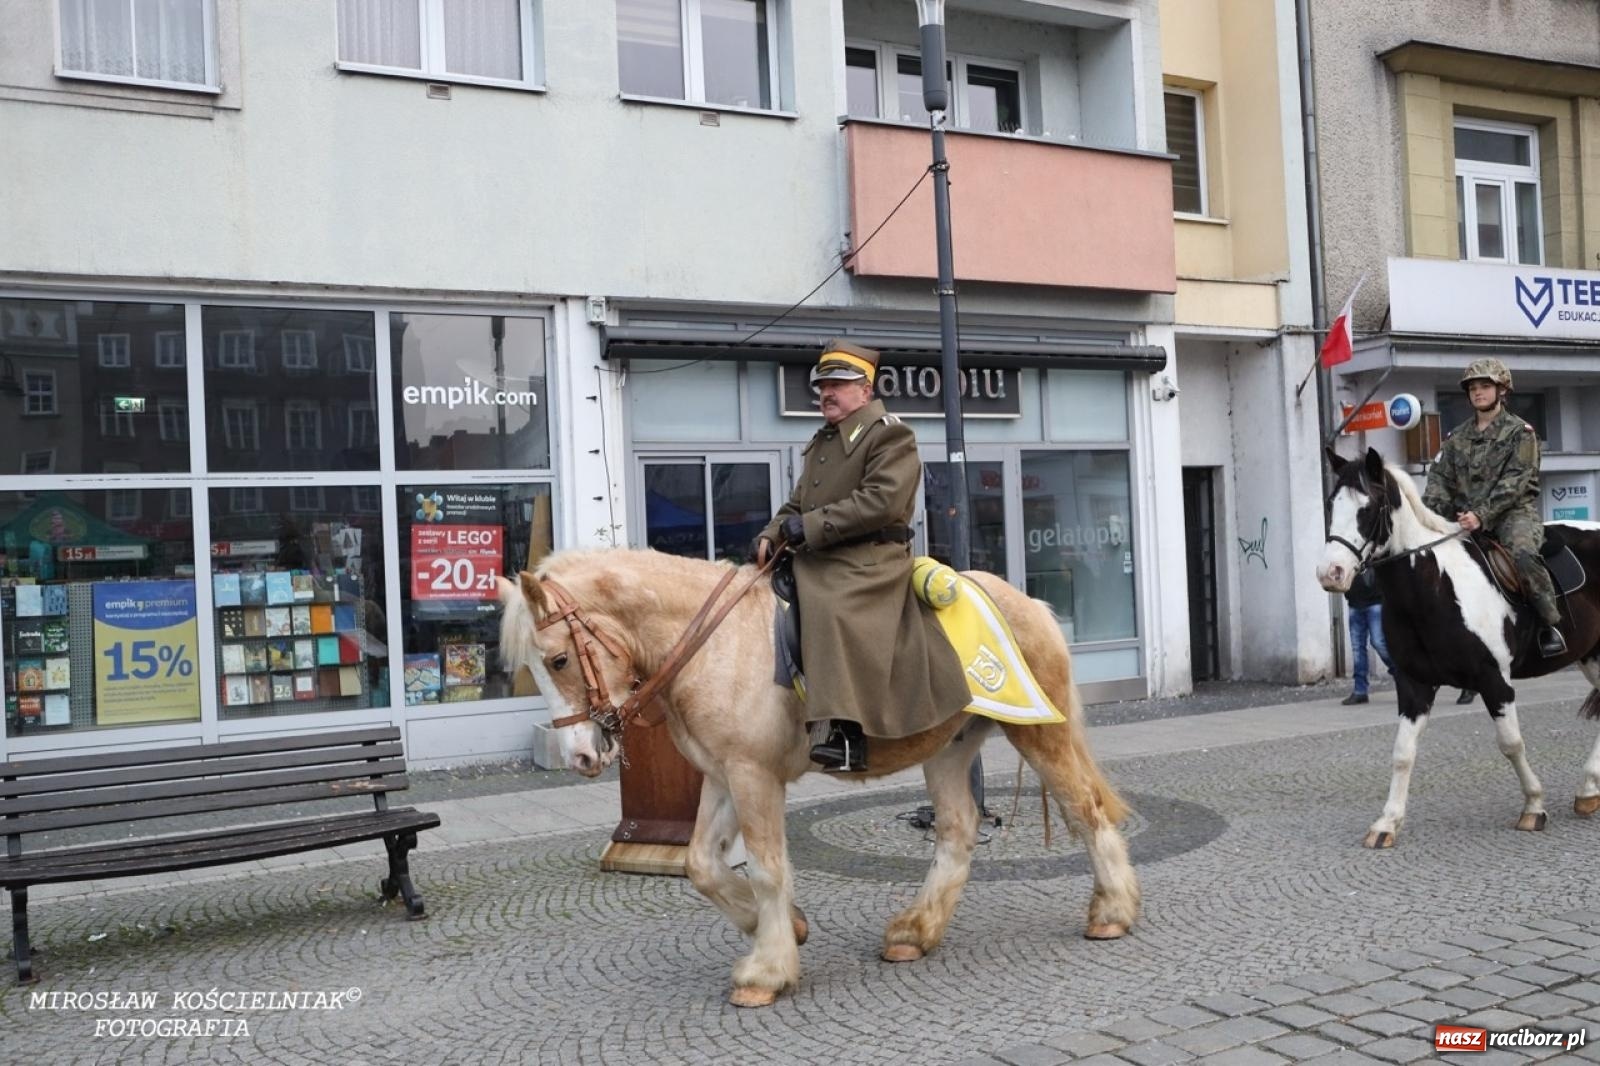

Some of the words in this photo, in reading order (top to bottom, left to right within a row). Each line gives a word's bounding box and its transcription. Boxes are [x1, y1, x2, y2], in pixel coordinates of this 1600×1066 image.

[402, 376, 537, 410] empik.com
[1567, 486, 1587, 495] TEB
[66, 549, 83, 560] 15
[418, 558, 475, 590] -20
[476, 568, 496, 590] zł
[105, 598, 136, 610] empik
[145, 599, 188, 610] premium
[103, 640, 193, 681] 15%
